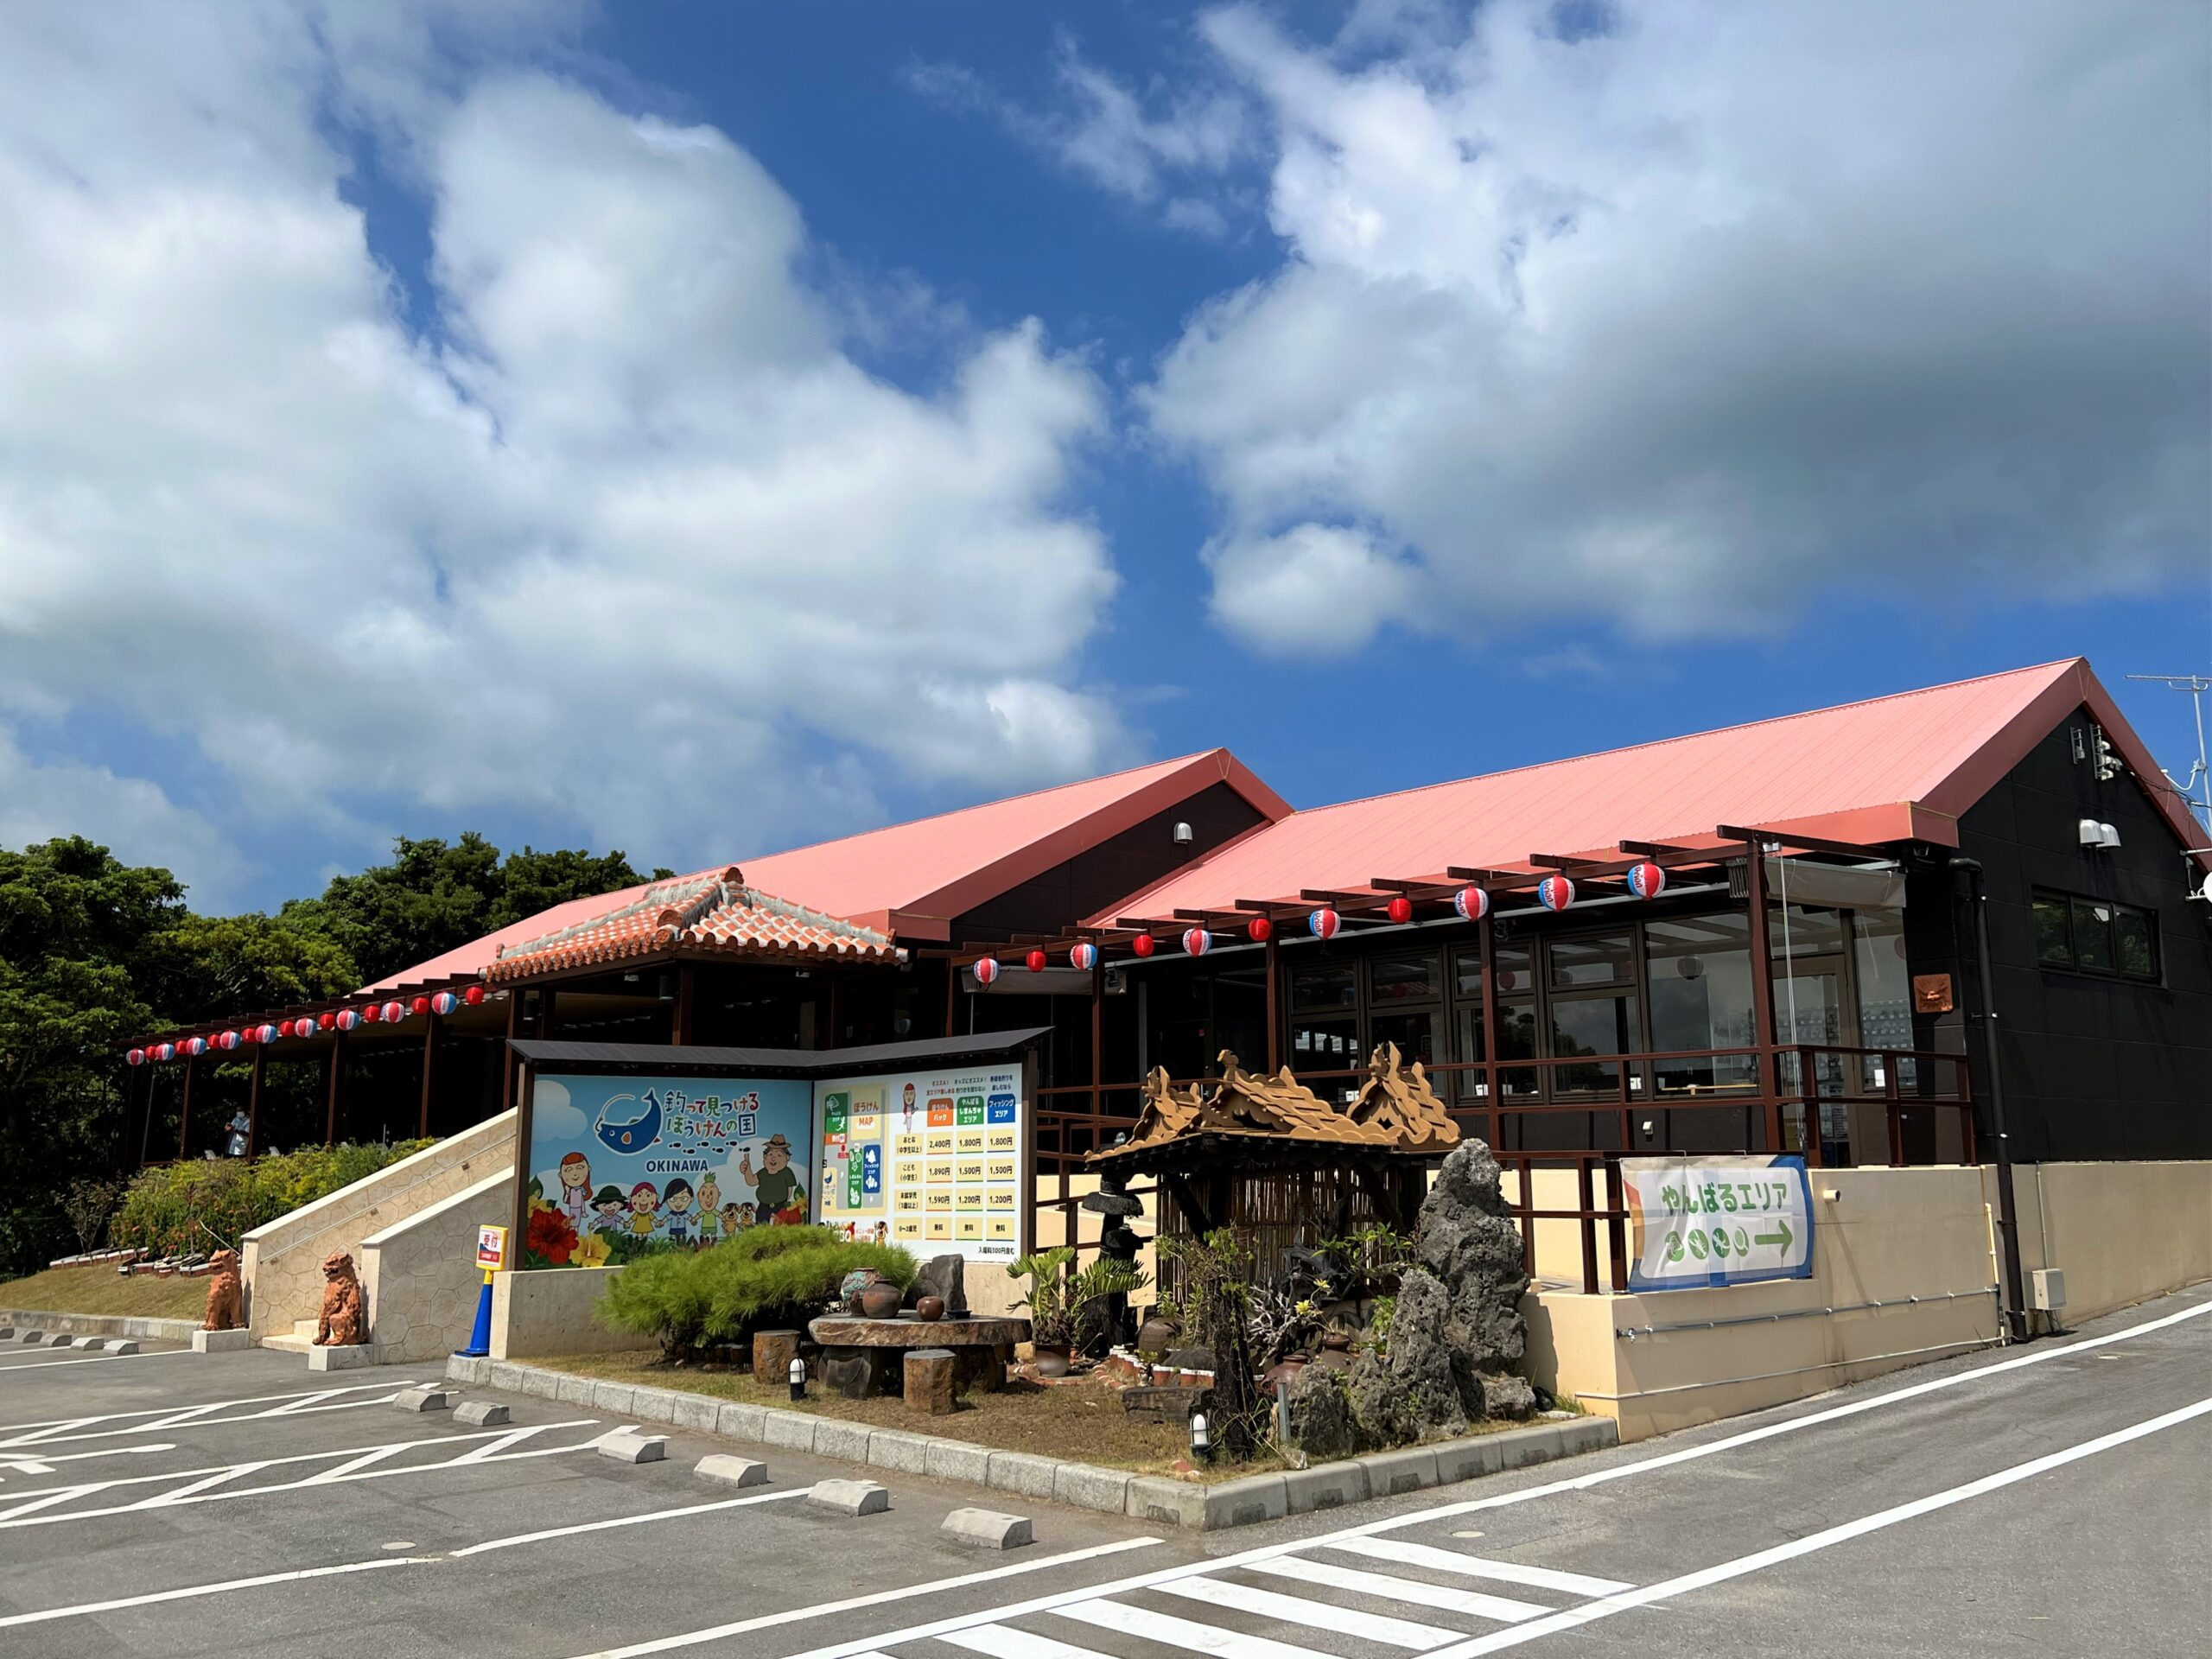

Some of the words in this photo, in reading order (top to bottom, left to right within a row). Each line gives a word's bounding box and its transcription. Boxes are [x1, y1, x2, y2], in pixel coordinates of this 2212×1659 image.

[664, 1091, 760, 1116] 釣って見つける
[962, 1097, 979, 1106] やんばる
[959, 1107, 982, 1116] しまんちゅ
[995, 1109, 1008, 1118] エリア
[859, 1116, 874, 1126] MAP
[929, 1139, 950, 1148] 2,400円
[959, 1138, 982, 1147] 1,800円
[990, 1136, 1013, 1146] 1,800円
[646, 1160, 709, 1173] OKINAWA
[959, 1166, 981, 1175] 1,500円
[989, 1166, 1013, 1175] 1,500円
[929, 1196, 950, 1205] 1,590円
[958, 1196, 981, 1205] 1,200円
[989, 1195, 1013, 1205] 1,200円
[1662, 1182, 1787, 1216] やんばるエリア
[484, 1234, 498, 1248] 受付
